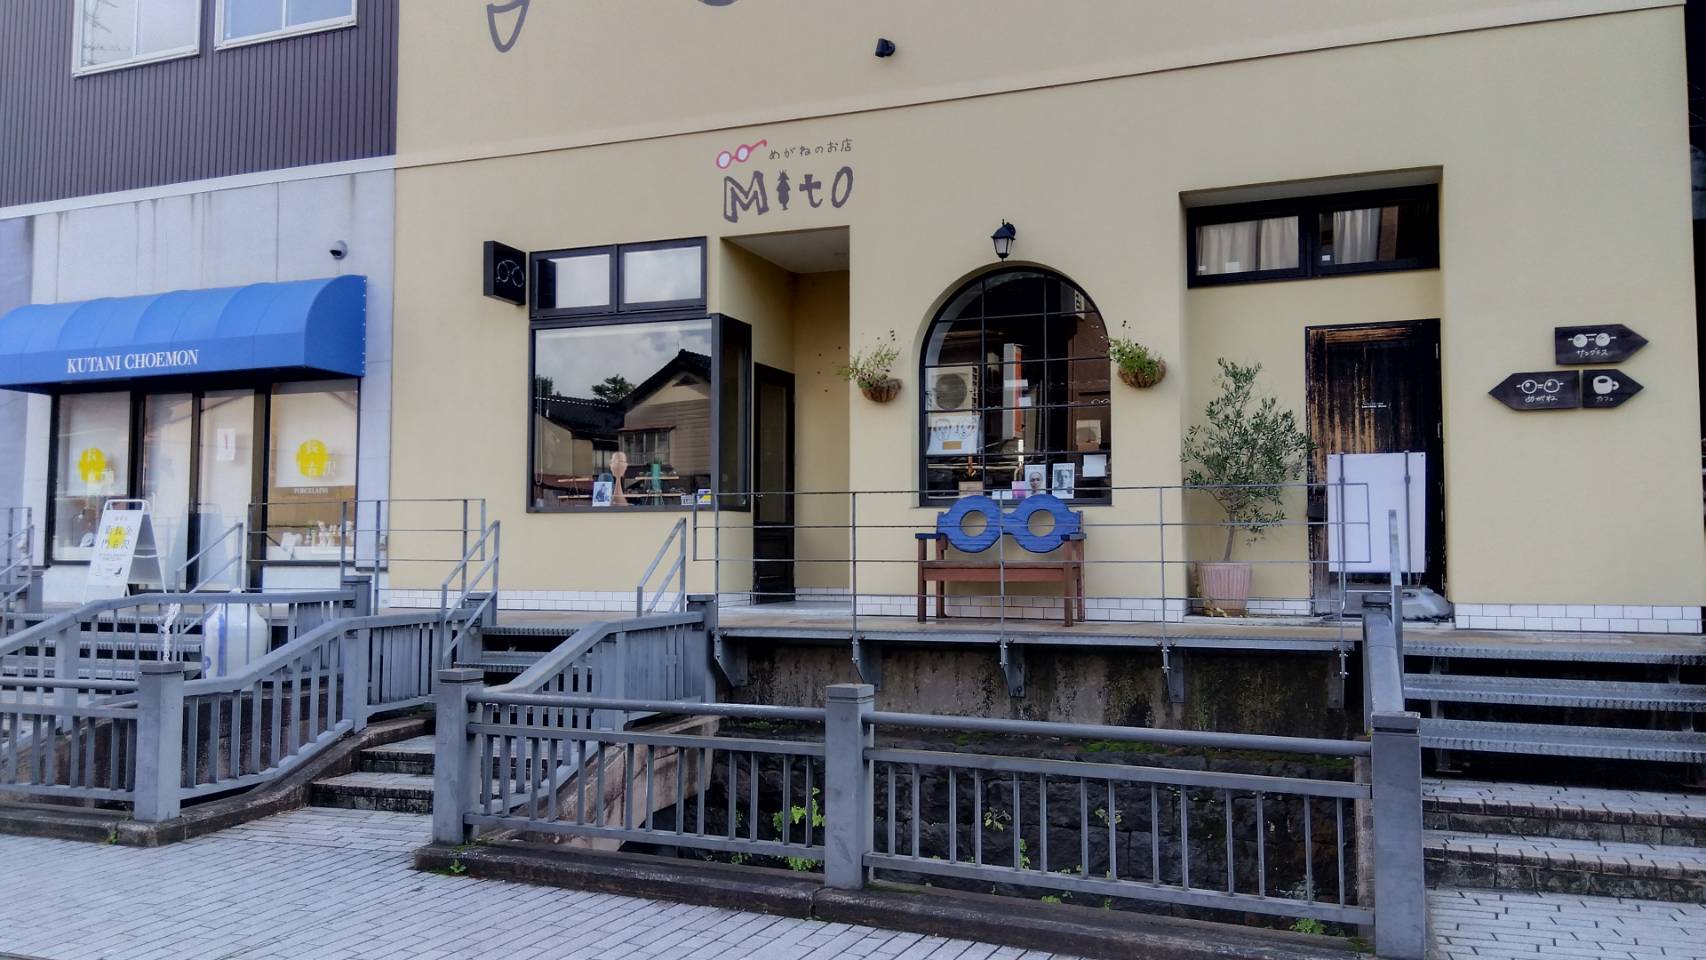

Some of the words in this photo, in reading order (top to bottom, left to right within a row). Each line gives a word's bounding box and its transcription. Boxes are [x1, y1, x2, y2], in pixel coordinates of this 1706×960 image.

[769, 138, 853, 160] めがねのお店
[1576, 347, 1609, 357] サングラス
[67, 355, 121, 374] KUTANI
[124, 349, 200, 370] CHOEMON
[1524, 395, 1558, 403] めがね
[1595, 395, 1614, 403] カフェ
